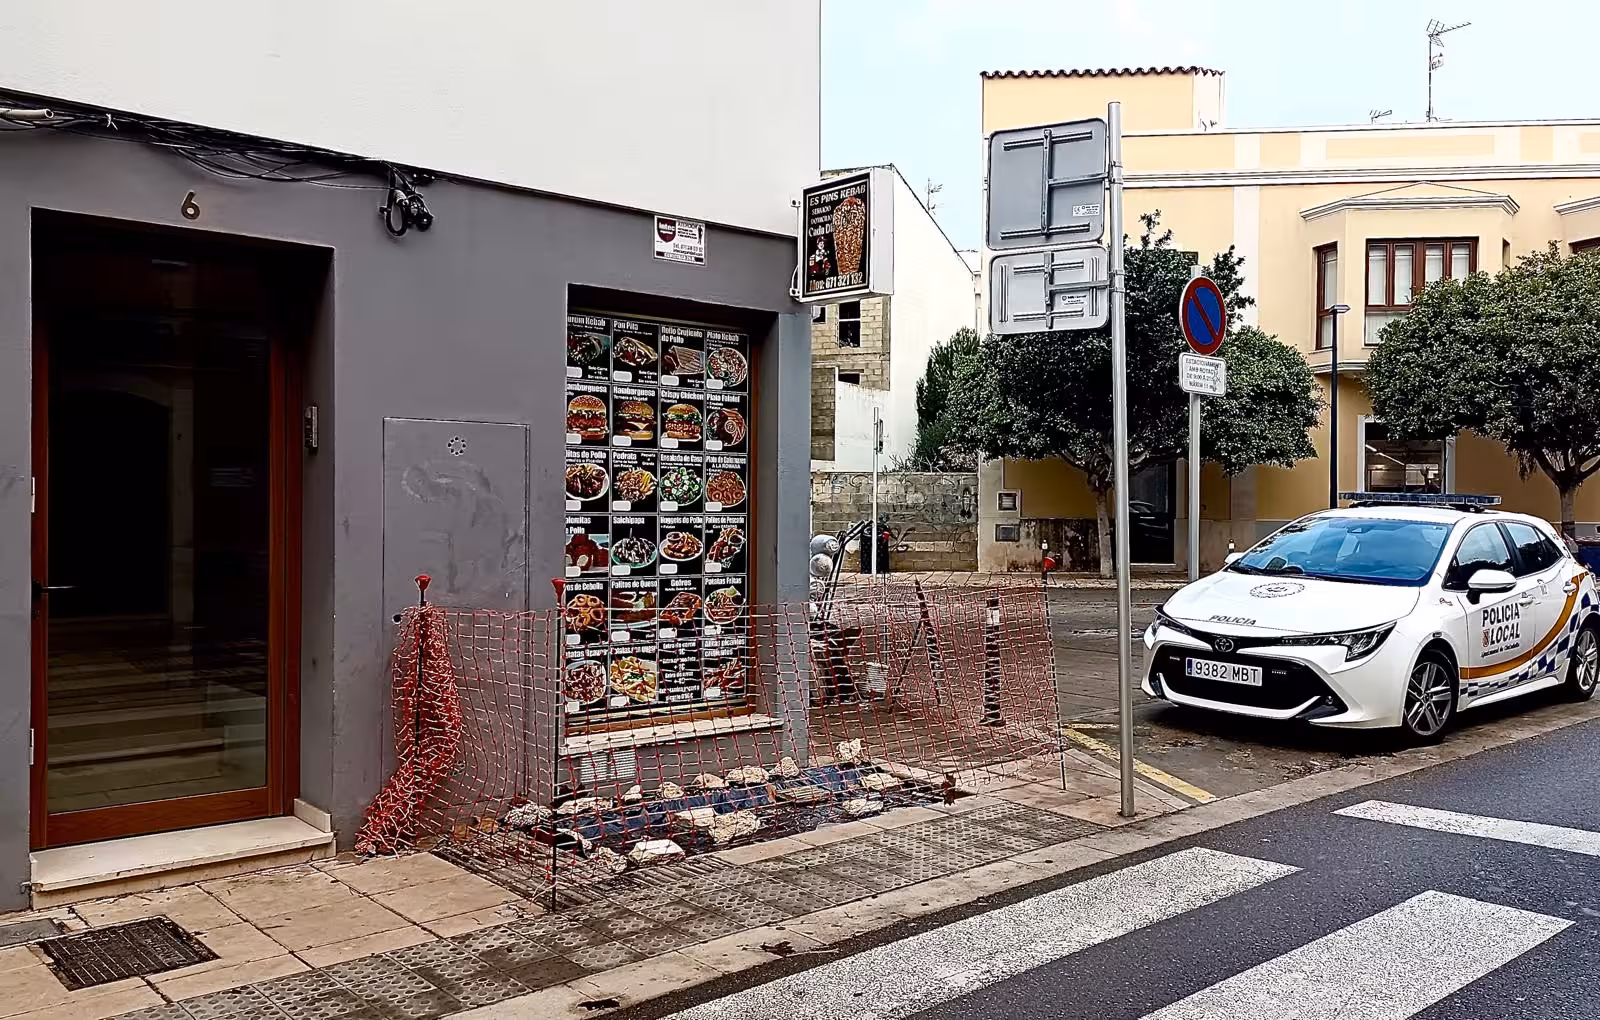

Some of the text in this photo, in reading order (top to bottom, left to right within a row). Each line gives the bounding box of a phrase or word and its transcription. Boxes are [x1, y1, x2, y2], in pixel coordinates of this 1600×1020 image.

[810, 184, 866, 206] ES PINS KEBAB
[181, 191, 200, 220] 6
[809, 225, 824, 237] Cada
[826, 276, 836, 288] 671
[838, 274, 849, 286] 321
[851, 272, 863, 284] 132
[585, 317, 606, 327] Kebab
[614, 320, 625, 329] Pan
[626, 322, 638, 330] Pita
[662, 334, 684, 343] de Pollo
[707, 332, 721, 340] Plato
[567, 383, 607, 392] amburguesa
[614, 386, 655, 396] Hamburguesa
[661, 390, 703, 400] Crispy Chicken
[566, 450, 606, 459] litas de Pollo
[613, 452, 637, 460] Pedrata
[613, 516, 645, 524] Salchipapa
[660, 516, 681, 524] Nuggets
[582, 582, 603, 590] Cebolla
[671, 579, 692, 587] Gofres
[1209, 615, 1256, 625] POLICIA
[1482, 603, 1520, 627] POLICIA
[1490, 622, 1520, 645] LOCAL
[566, 650, 584, 658] atatas
[1195, 661, 1228, 679] 9382
[1232, 666, 1258, 683] MBT
